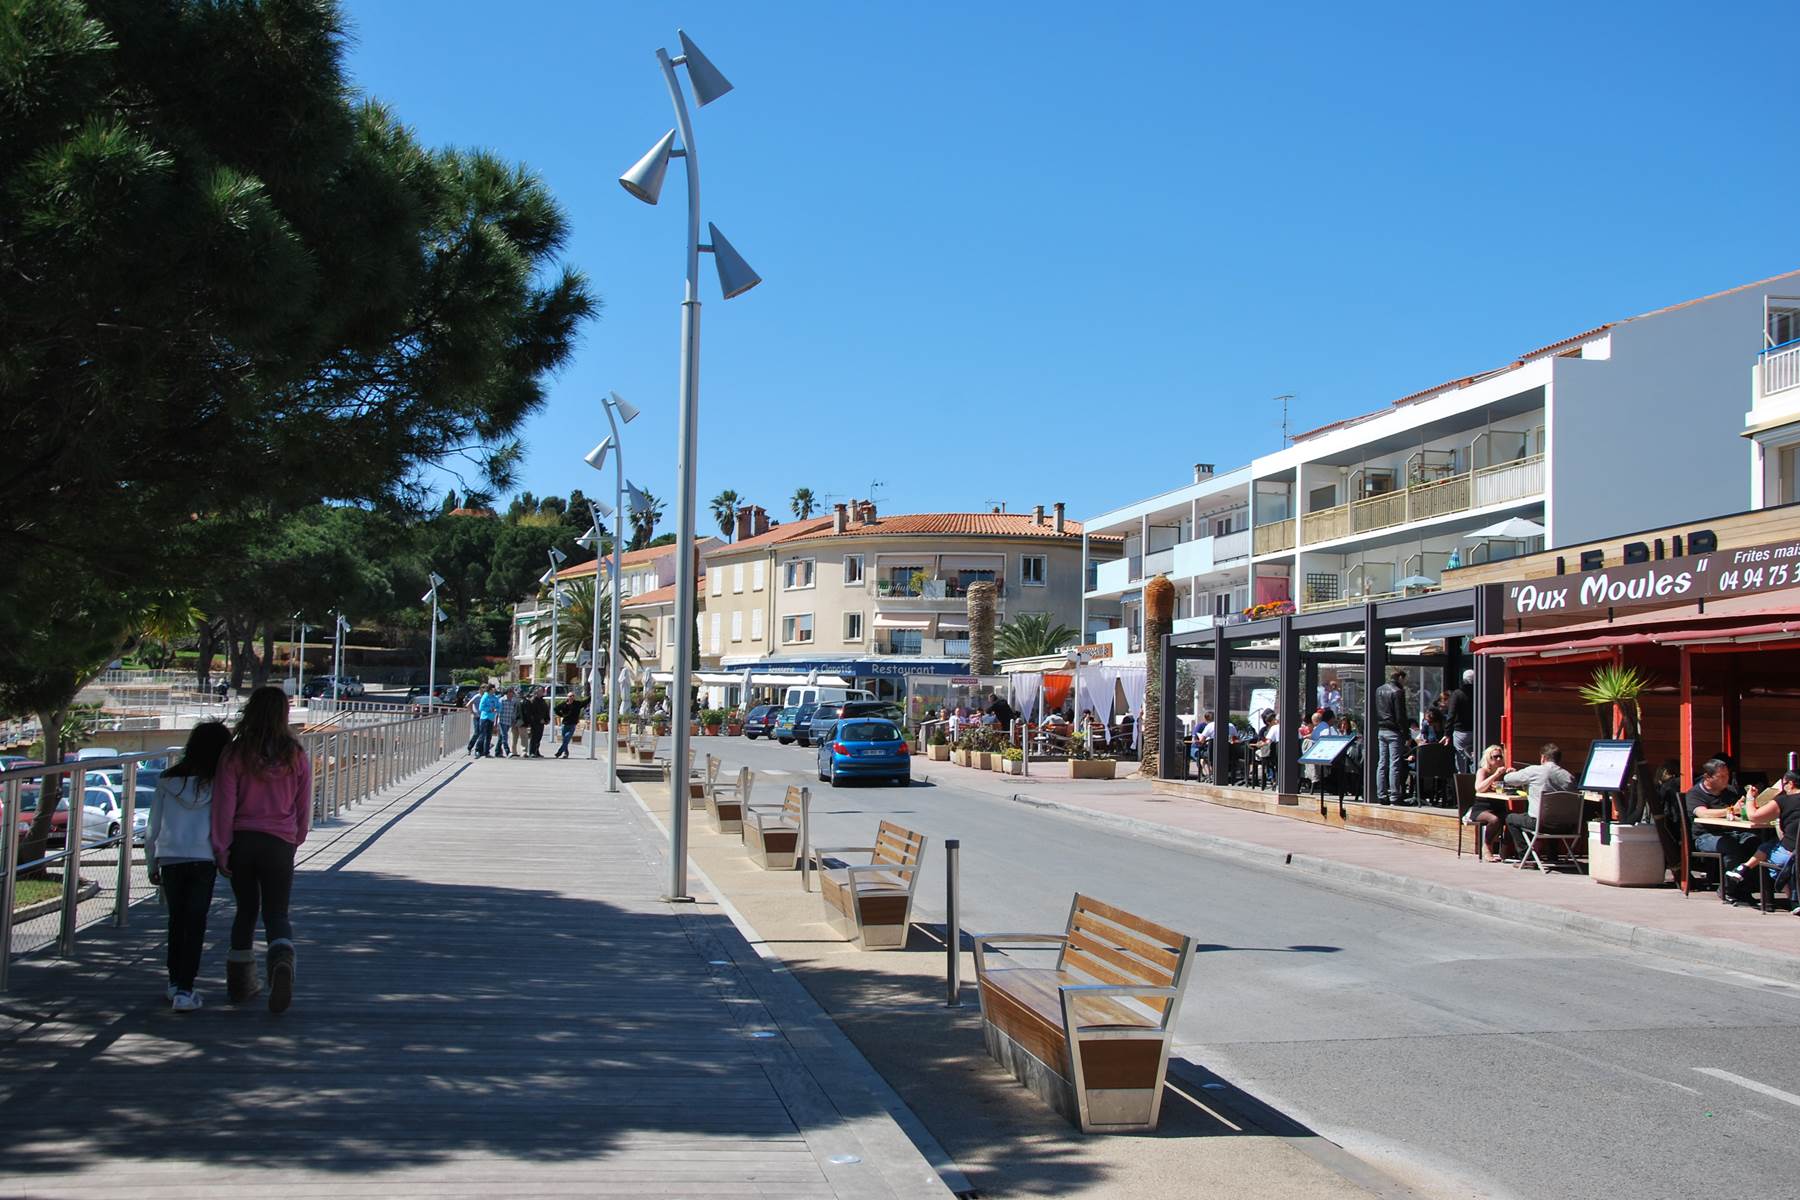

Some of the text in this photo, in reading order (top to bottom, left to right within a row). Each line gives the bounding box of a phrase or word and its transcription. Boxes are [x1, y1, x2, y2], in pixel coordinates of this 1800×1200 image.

[1734, 550, 1770, 564] Frites
[1719, 570, 1739, 591] 04
[1742, 567, 1763, 589] 94
[1769, 563, 1789, 586] 75
[871, 663, 936, 675] Restaurant
